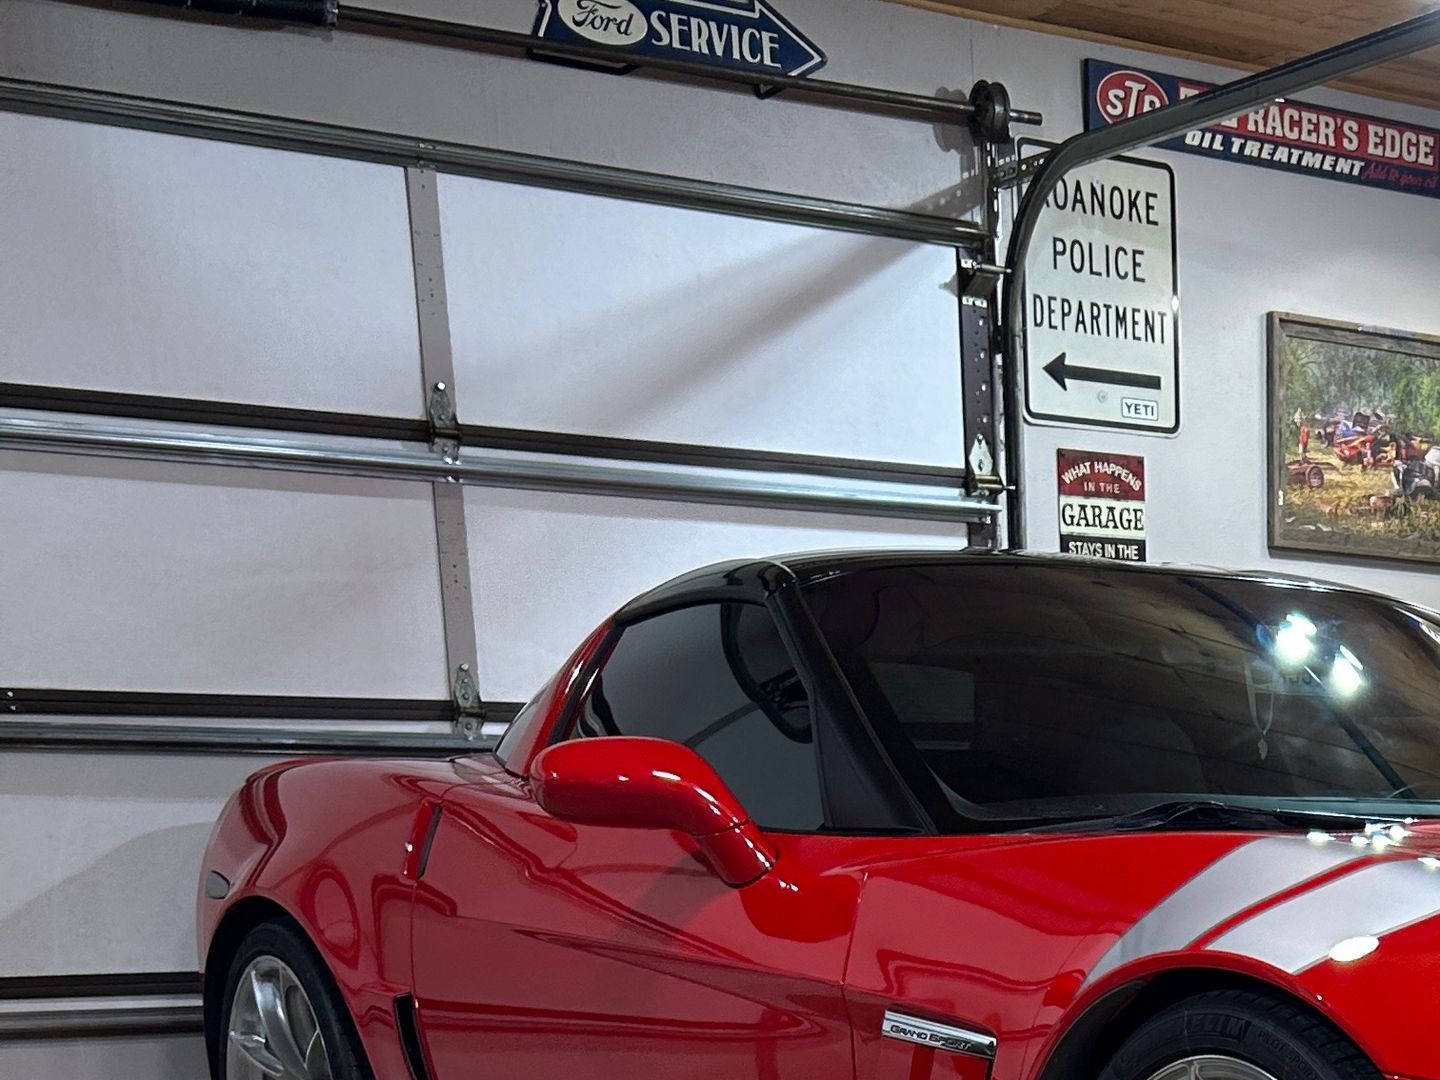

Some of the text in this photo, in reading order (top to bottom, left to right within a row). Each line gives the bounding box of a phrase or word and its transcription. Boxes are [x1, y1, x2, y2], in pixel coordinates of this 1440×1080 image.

[572, 0, 782, 68] Ford SERVICE
[1184, 130, 1365, 176] OIL TREATMENT
[1247, 105, 1360, 152] RACER'S
[1367, 124, 1435, 166] EDGE
[1044, 175, 1159, 226] OANOKE
[1052, 236, 1146, 283] POLICE
[1032, 294, 1167, 344] DEPARTMENT
[1124, 401, 1155, 417] YETI
[1061, 461, 1142, 492] WHAT HAPPENS
[1084, 481, 1120, 494] IN THE
[1061, 503, 1145, 531] GARAGE
[1068, 541, 1139, 560] STAYS IN THE
[890, 1024, 974, 1051] GRAND SPORT
